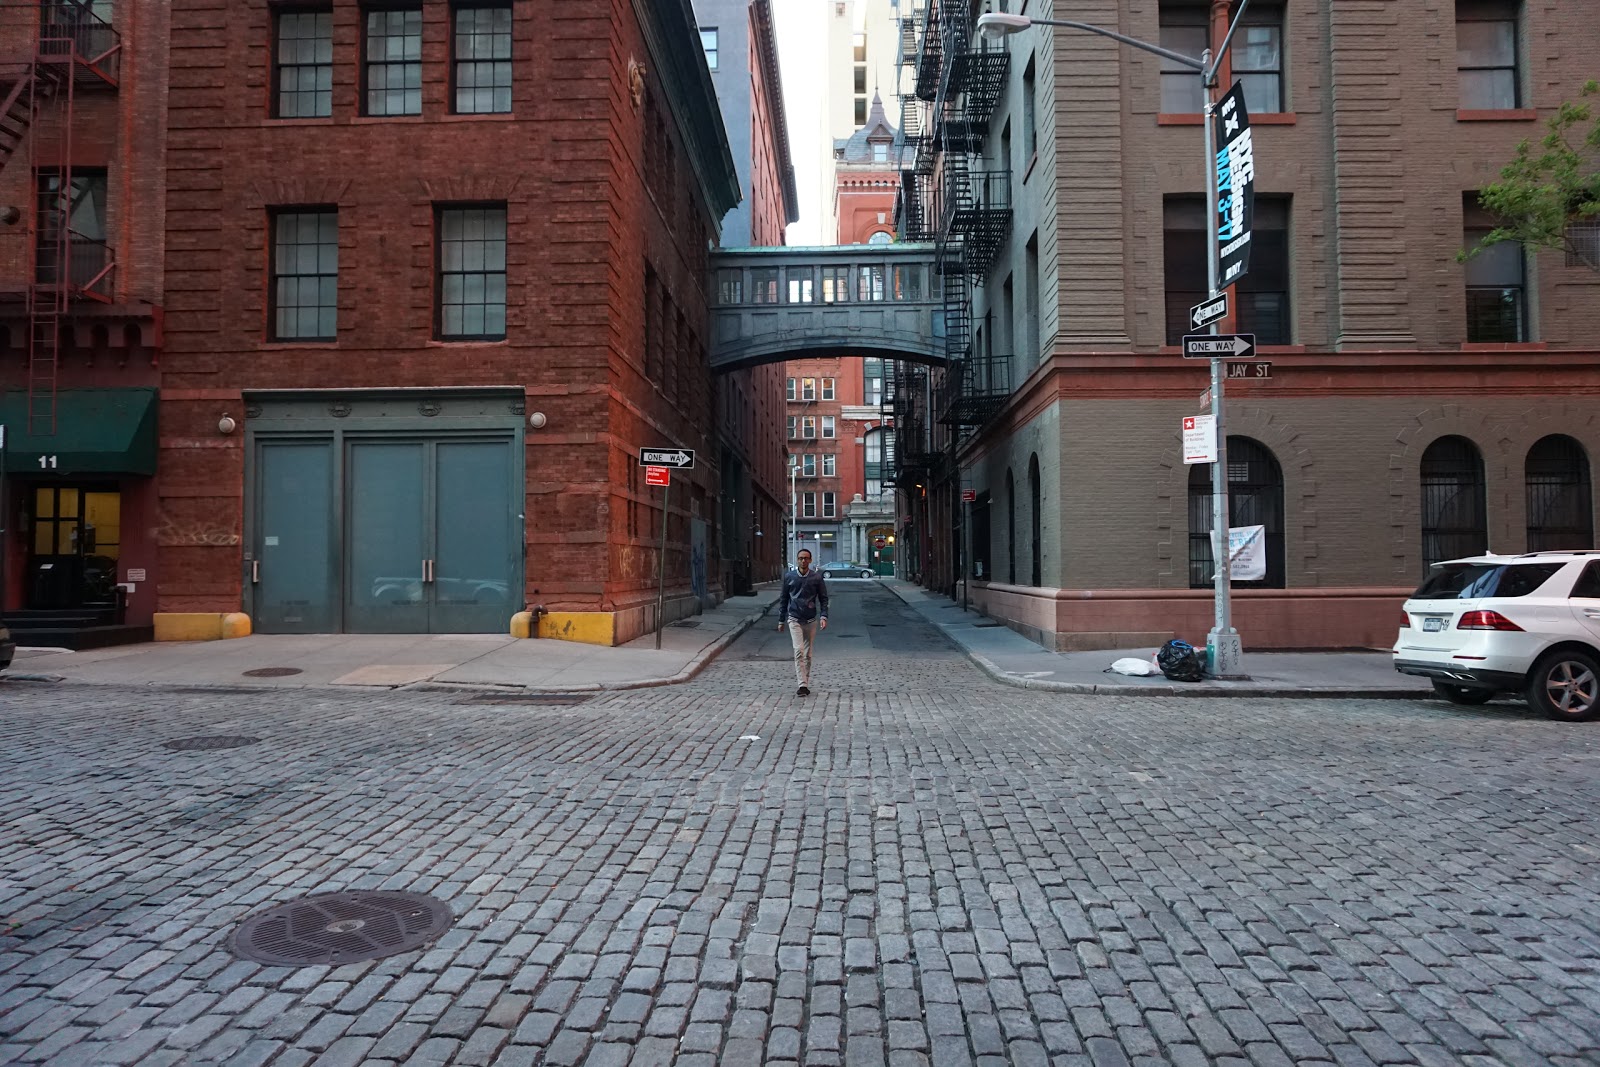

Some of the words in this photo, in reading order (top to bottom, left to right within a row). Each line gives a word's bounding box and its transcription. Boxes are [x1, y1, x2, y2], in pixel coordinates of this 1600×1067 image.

[1225, 111, 1239, 138] X
[1239, 127, 1254, 186] NYC
[1216, 146, 1231, 192] MAY
[1227, 137, 1243, 239] DESIGN
[1218, 195, 1232, 240] 3-17
[1196, 309, 1206, 321] ONE
[1211, 302, 1223, 314] WAY
[1191, 342, 1210, 351] ONE
[1215, 341, 1235, 351] WAY
[1229, 364, 1247, 377] JAY
[1256, 364, 1269, 377] ST
[38, 455, 57, 468] 11
[647, 453, 663, 461] ONE
[669, 455, 686, 463] WAY
